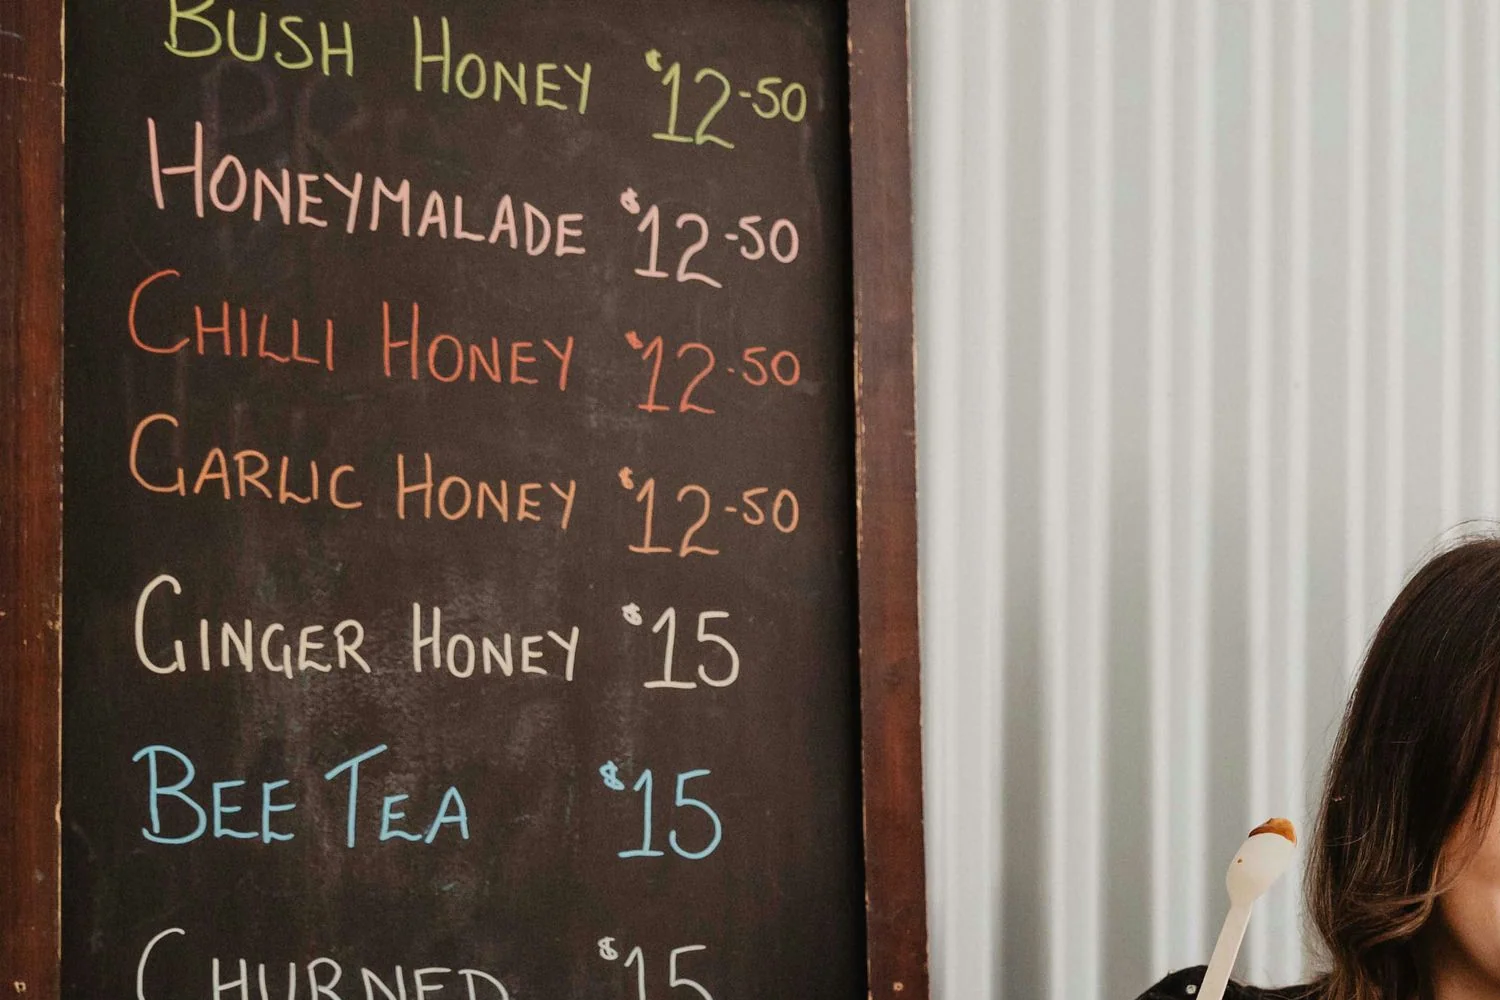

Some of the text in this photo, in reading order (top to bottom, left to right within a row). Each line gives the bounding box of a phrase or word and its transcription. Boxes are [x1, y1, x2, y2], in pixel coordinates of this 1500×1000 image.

[164, 0, 353, 76] BUSH
[413, 16, 591, 114] HONEY
[147, 117, 585, 256] HONEYMALADE
[128, 269, 333, 371] CHILLI
[383, 301, 573, 391] HONEY
[129, 413, 362, 509] GARLIC
[397, 453, 576, 529] HONEY
[135, 574, 739, 689] GINGER HONEY $15
[132, 745, 721, 859] BEE TEA $15
